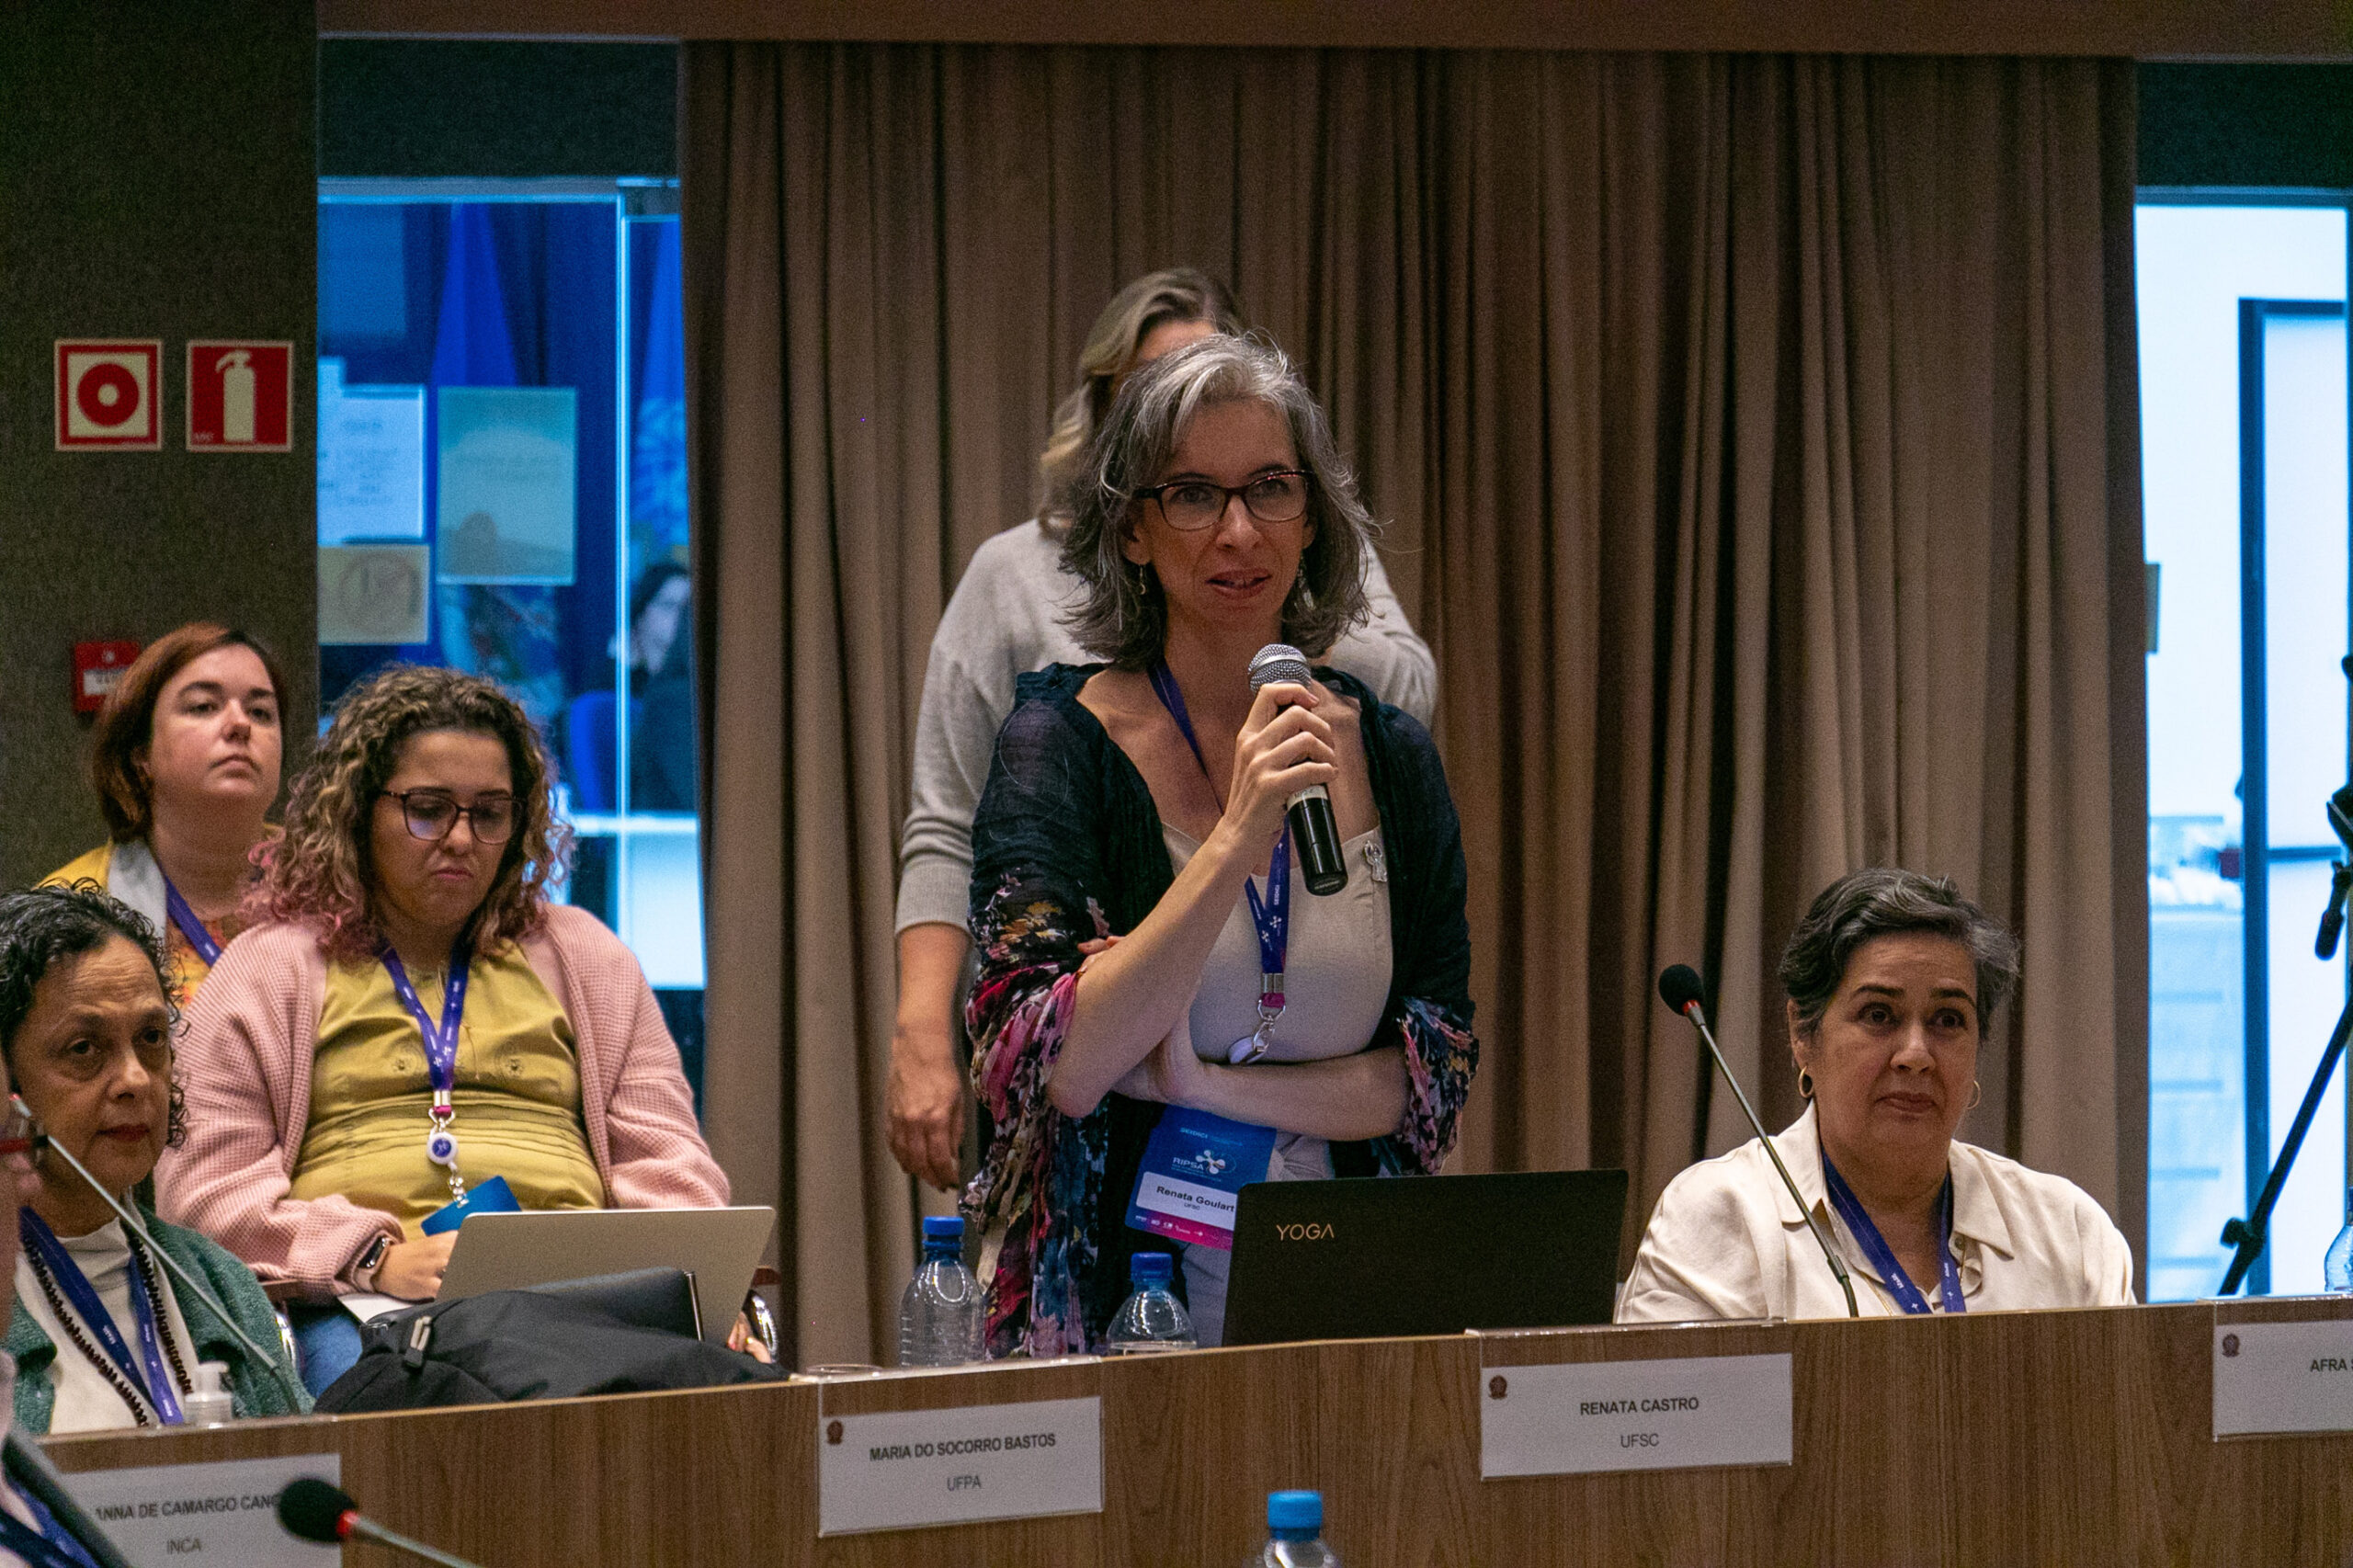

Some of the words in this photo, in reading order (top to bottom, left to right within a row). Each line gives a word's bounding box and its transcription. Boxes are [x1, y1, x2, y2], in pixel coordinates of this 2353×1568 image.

[1173, 1157, 1204, 1171] RIPSA
[1156, 1186, 1193, 1202] Renata
[1196, 1196, 1235, 1212] Goulart
[1276, 1223, 1335, 1242] YOGA
[2310, 1358, 2347, 1372] AFRA
[1580, 1401, 1638, 1415] RENATA
[1641, 1396, 1699, 1413] CASTRO
[870, 1445, 912, 1461] MARIA
[915, 1443, 934, 1459] DO
[937, 1437, 1002, 1457] SOCORRO
[1005, 1432, 1056, 1451] BASTOS
[1620, 1433, 1660, 1449] UFSC
[946, 1474, 982, 1492] UFPA
[139, 1503, 158, 1517] DE
[161, 1496, 237, 1517] CAMARGO
[166, 1537, 202, 1556] INCA
